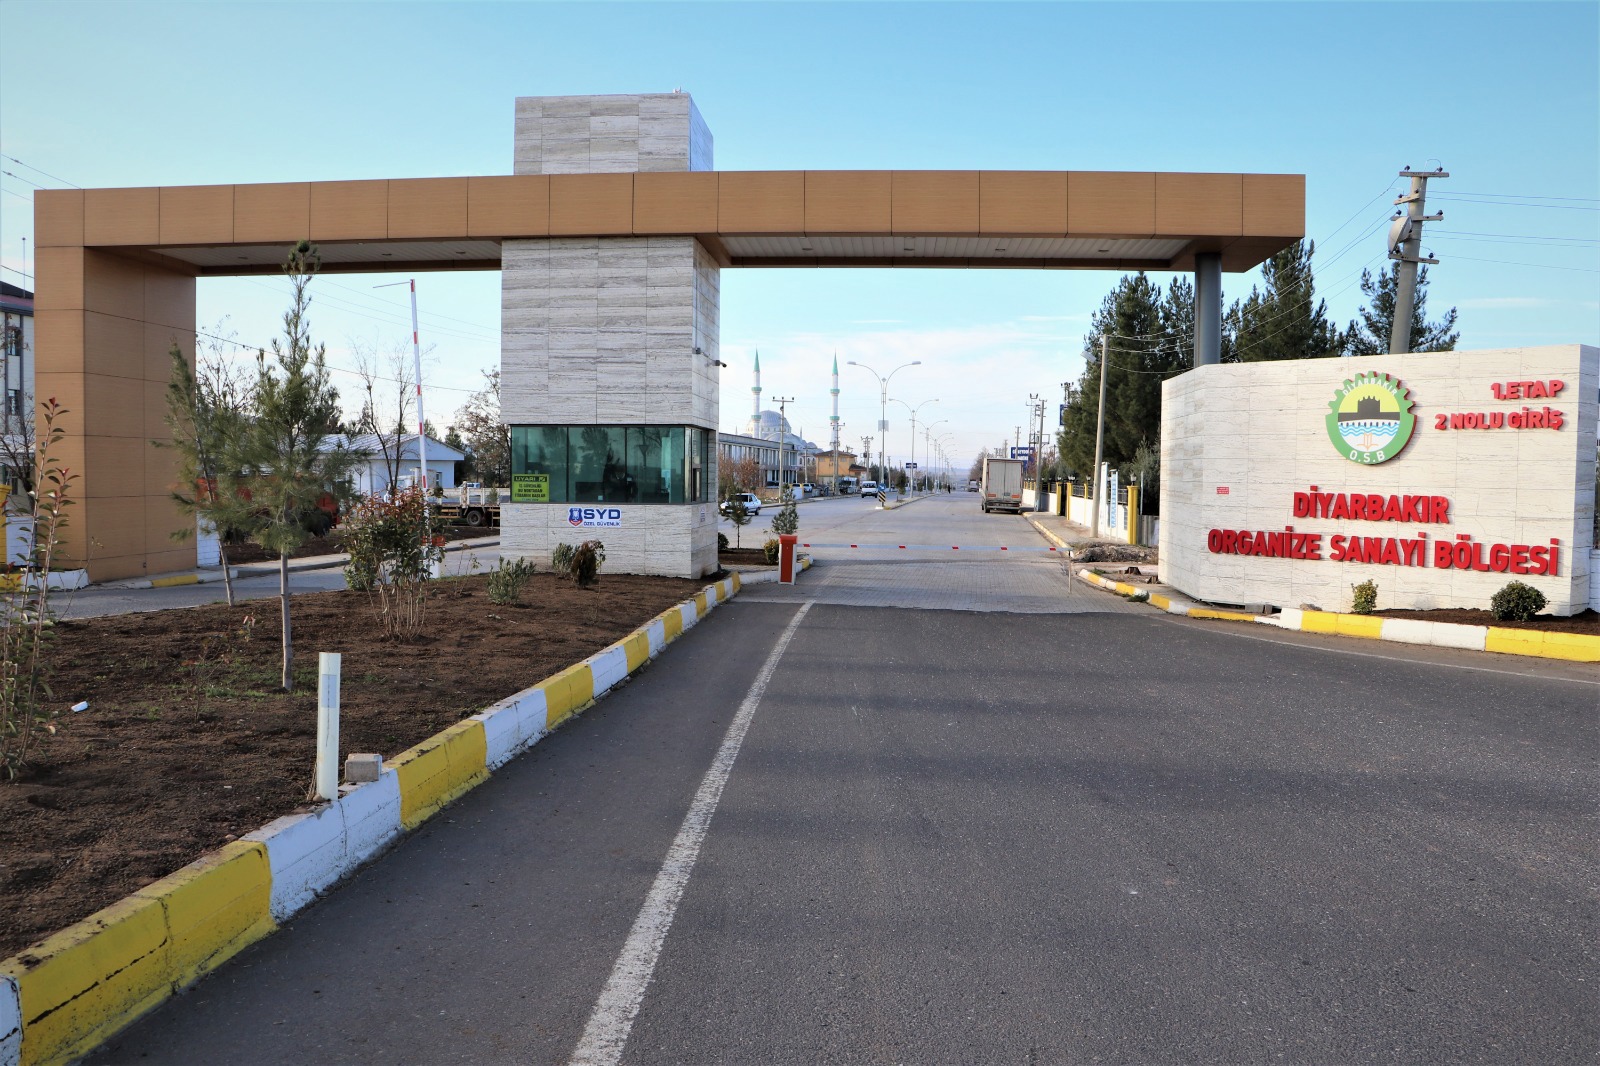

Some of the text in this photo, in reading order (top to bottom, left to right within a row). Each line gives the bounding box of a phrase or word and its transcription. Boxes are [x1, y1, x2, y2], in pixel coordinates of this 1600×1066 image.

[1490, 380, 1564, 400] 1.ETAP
[1435, 406, 1564, 431] 2 NOLU GİRİŞ
[1349, 450, 1386, 463] O.S.B
[583, 509, 621, 519] SYD
[1293, 485, 1449, 524] DİYARBAKIR
[1207, 525, 1560, 576] ORGANİZE SANAYİ BÖLGESİ
